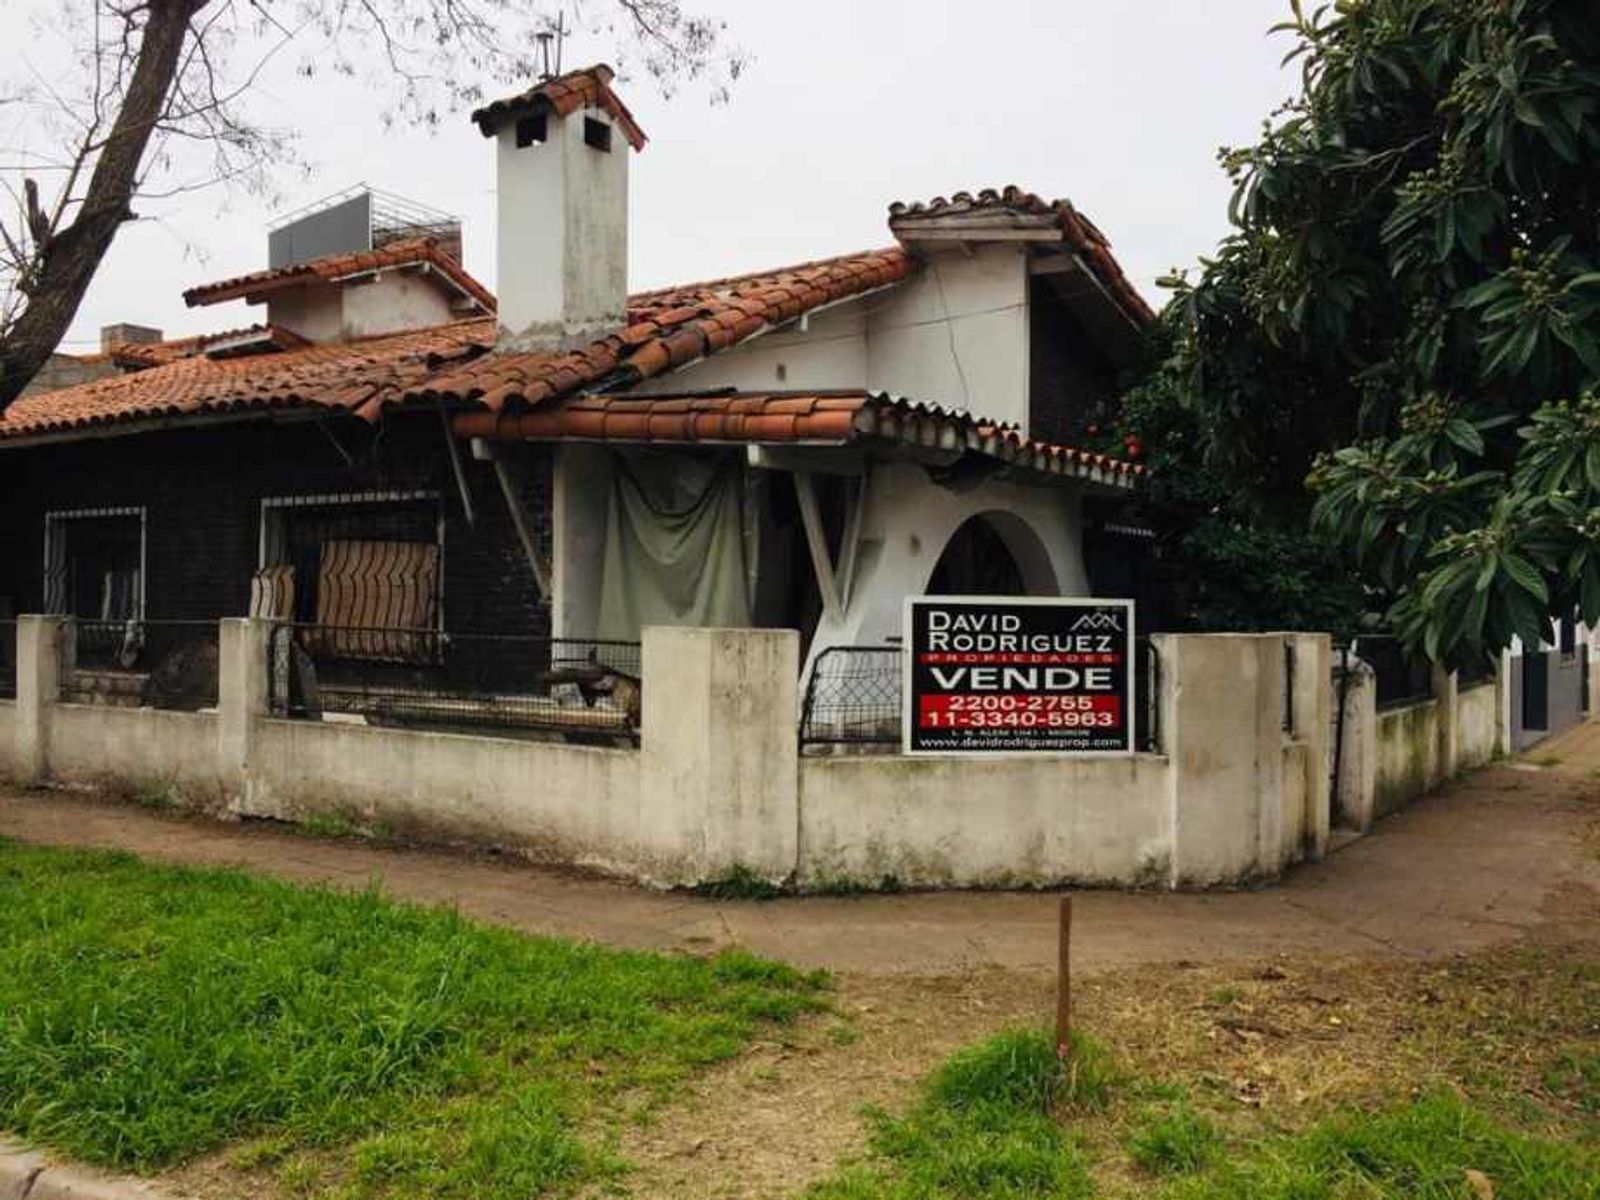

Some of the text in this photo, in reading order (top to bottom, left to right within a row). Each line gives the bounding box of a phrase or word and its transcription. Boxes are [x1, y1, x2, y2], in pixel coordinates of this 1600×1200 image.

[928, 611, 1020, 631] DAVID
[928, 632, 1112, 651] RODRIGUEZ
[929, 654, 1113, 663] PROPIEDADES
[930, 667, 1113, 690] VENDE
[950, 695, 1093, 710] 2200-2755
[928, 711, 1114, 726] 11-3340-5963
